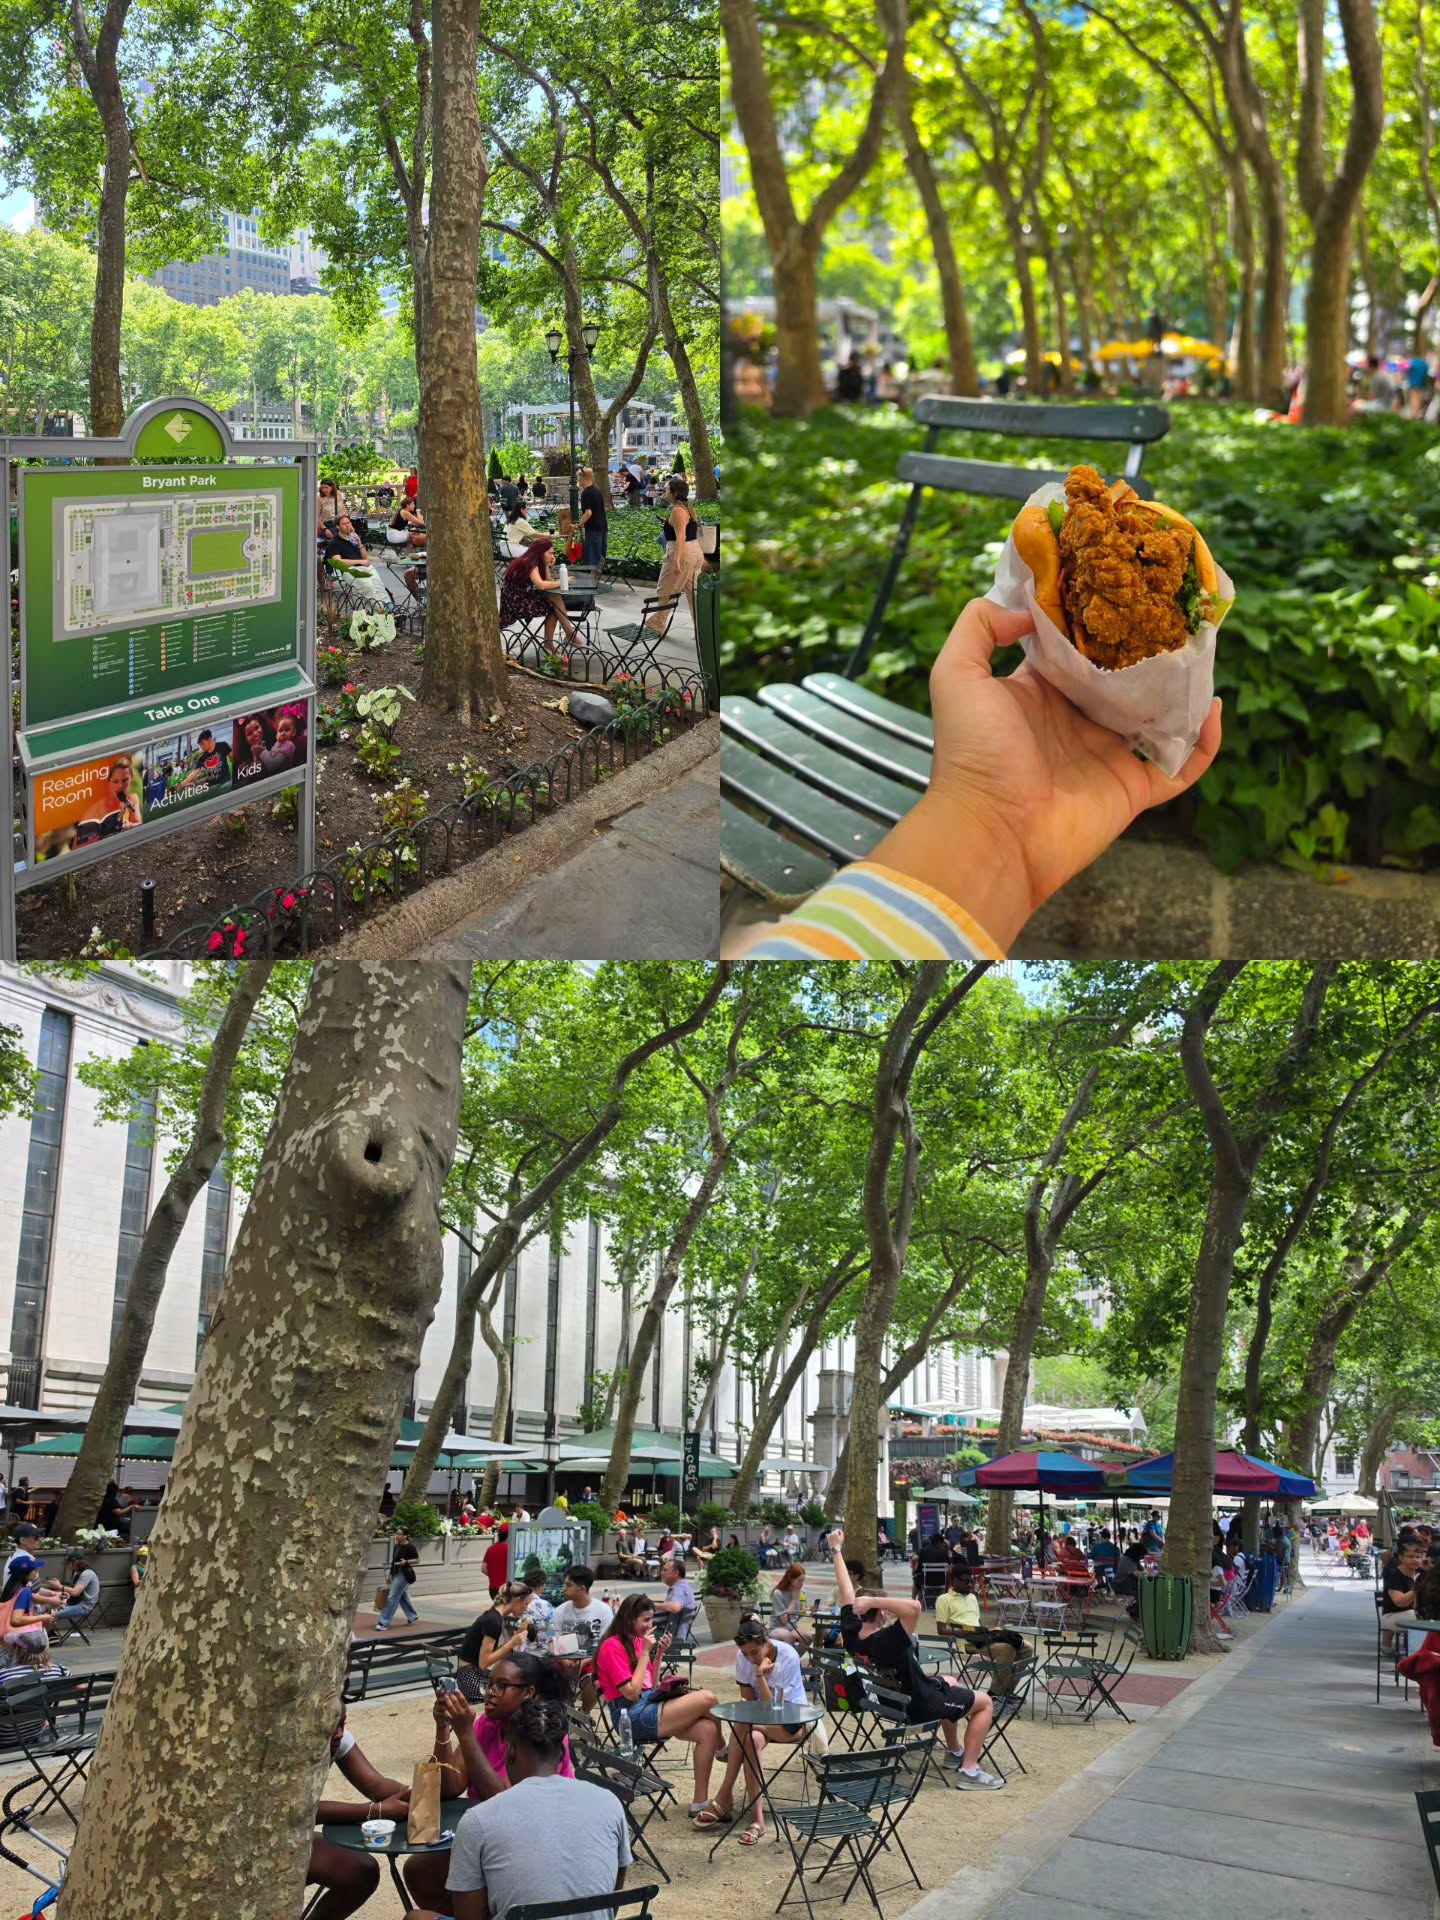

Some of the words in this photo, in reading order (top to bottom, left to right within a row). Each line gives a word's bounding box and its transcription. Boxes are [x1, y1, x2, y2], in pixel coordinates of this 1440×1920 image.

[143, 476, 186, 489] Bryant
[189, 474, 217, 486] Park
[144, 705, 184, 721] Take
[187, 695, 220, 710] One
[42, 766, 110, 795] Reading
[237, 762, 262, 780] Kids
[42, 787, 93, 812] Room
[150, 782, 209, 812] Activities
